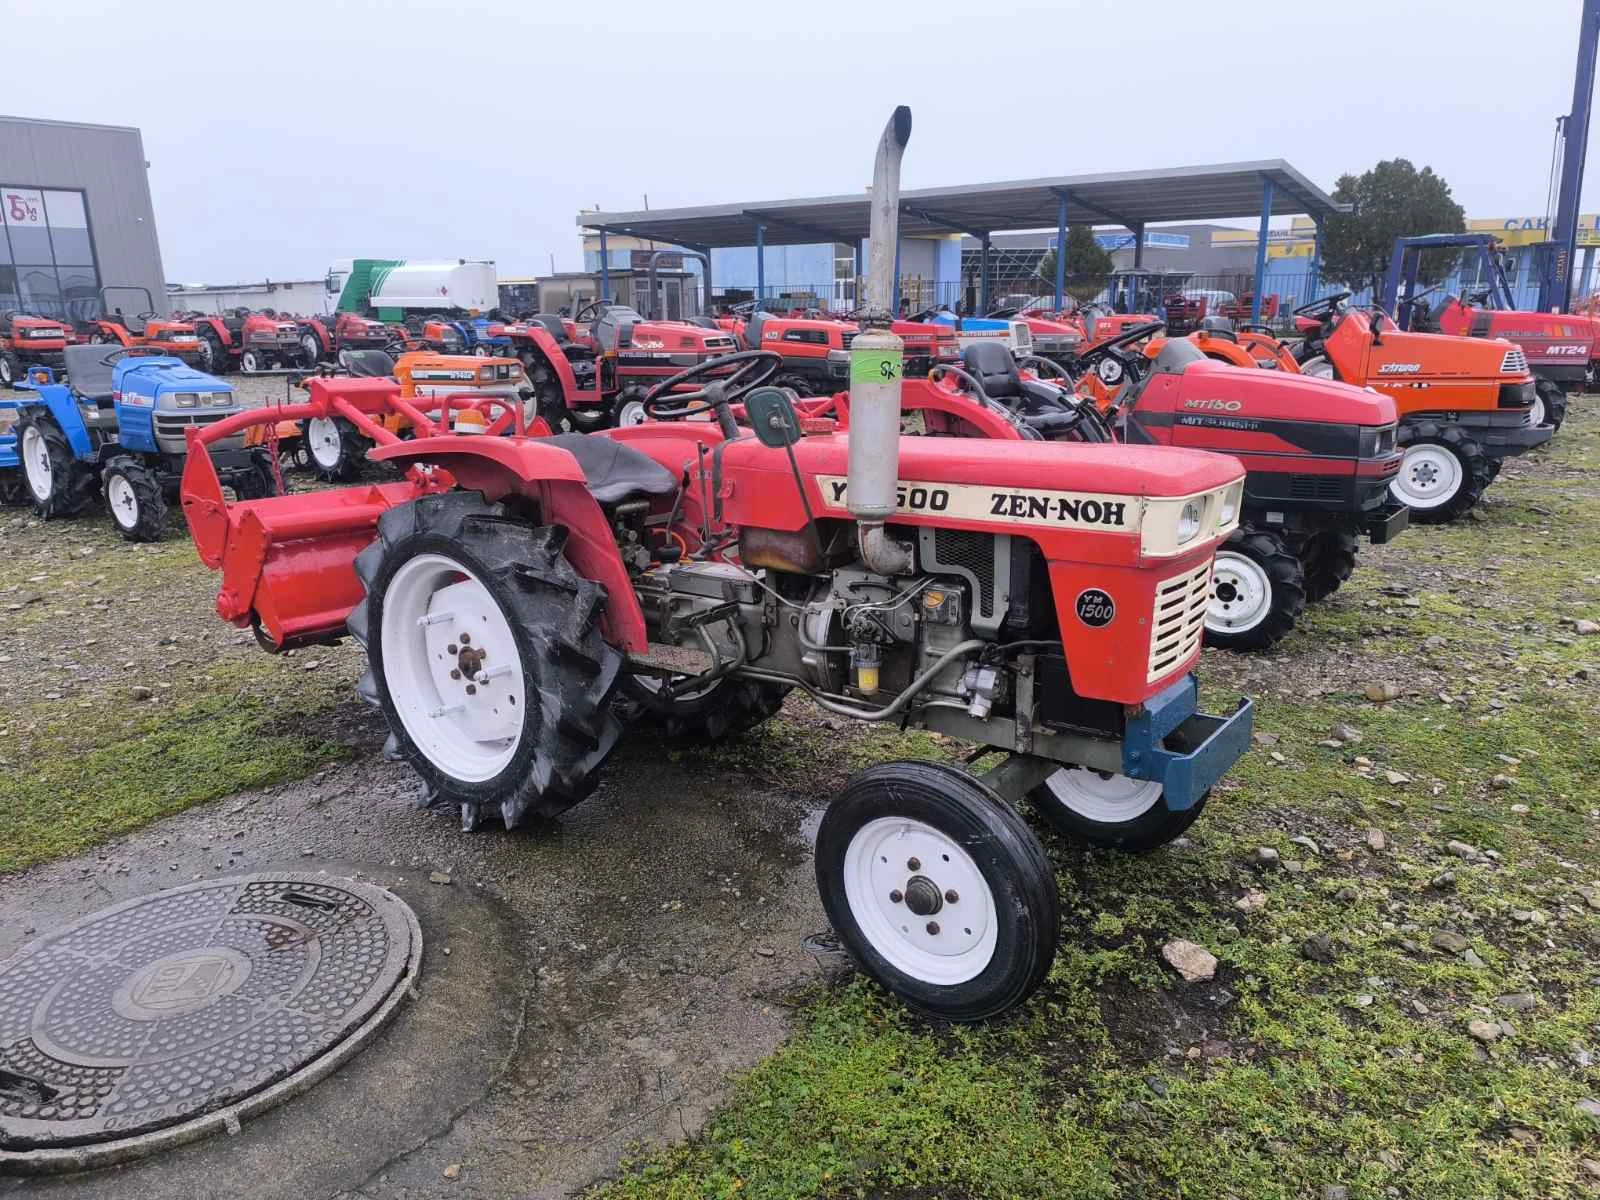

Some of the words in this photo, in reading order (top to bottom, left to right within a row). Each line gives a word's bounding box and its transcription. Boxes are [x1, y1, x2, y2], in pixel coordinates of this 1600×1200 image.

[1546, 345, 1588, 355] MT24
[832, 482, 949, 511] Y500
[990, 493, 1126, 525] ZEN-NOH
[1083, 594, 1103, 604] YM
[1080, 604, 1113, 619] 1500
